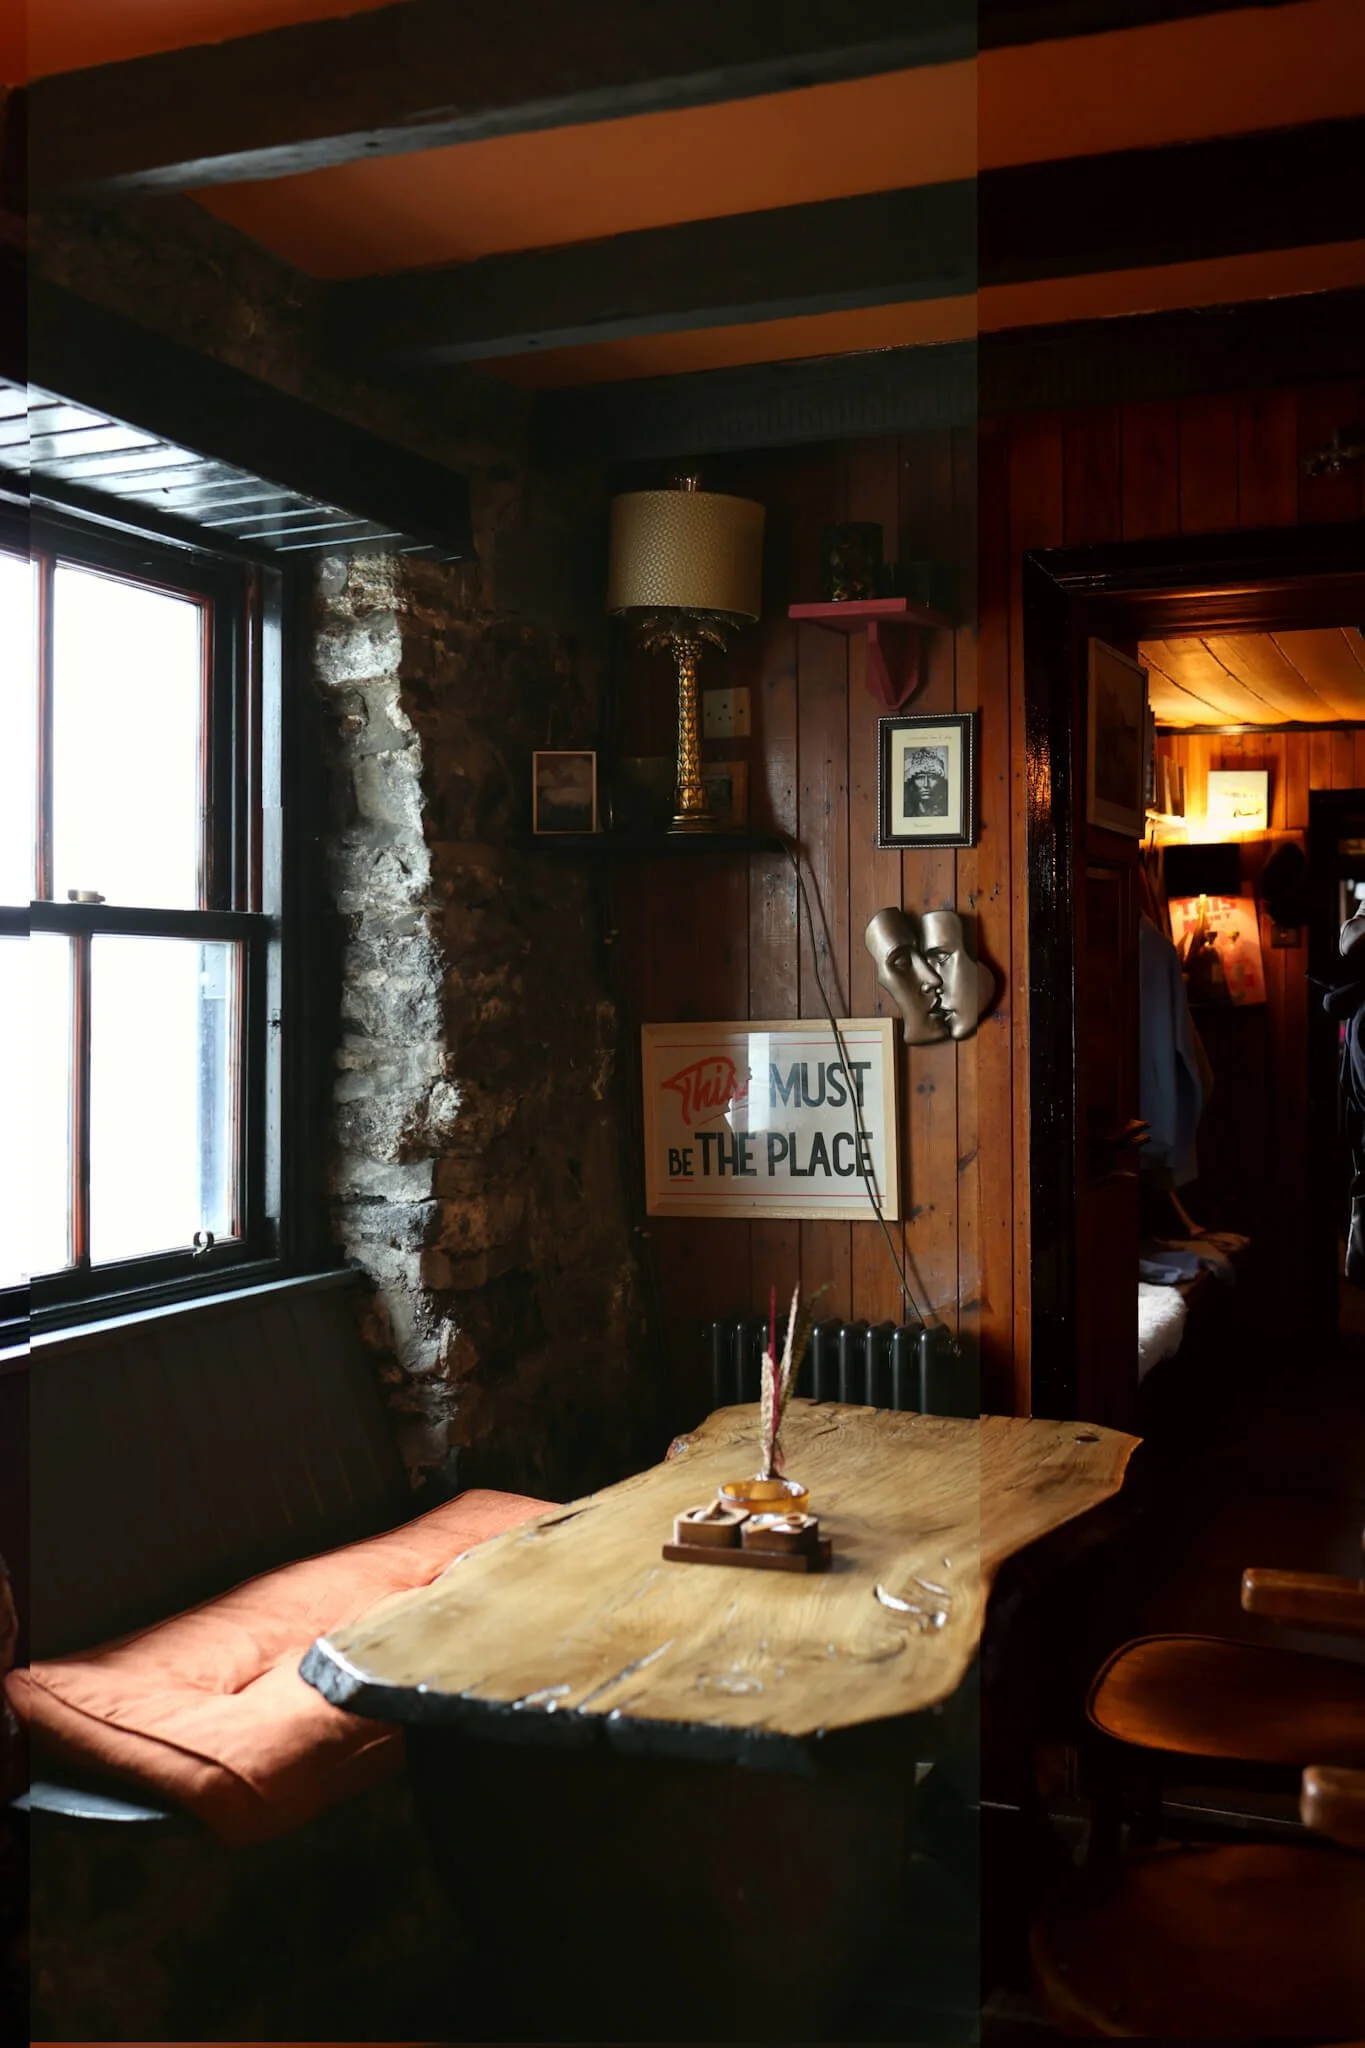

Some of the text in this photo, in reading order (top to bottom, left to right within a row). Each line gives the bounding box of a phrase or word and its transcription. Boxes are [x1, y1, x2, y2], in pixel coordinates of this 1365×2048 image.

[769, 1062, 872, 1108] MUST
[668, 1132, 874, 1177] BE THE PLACE
